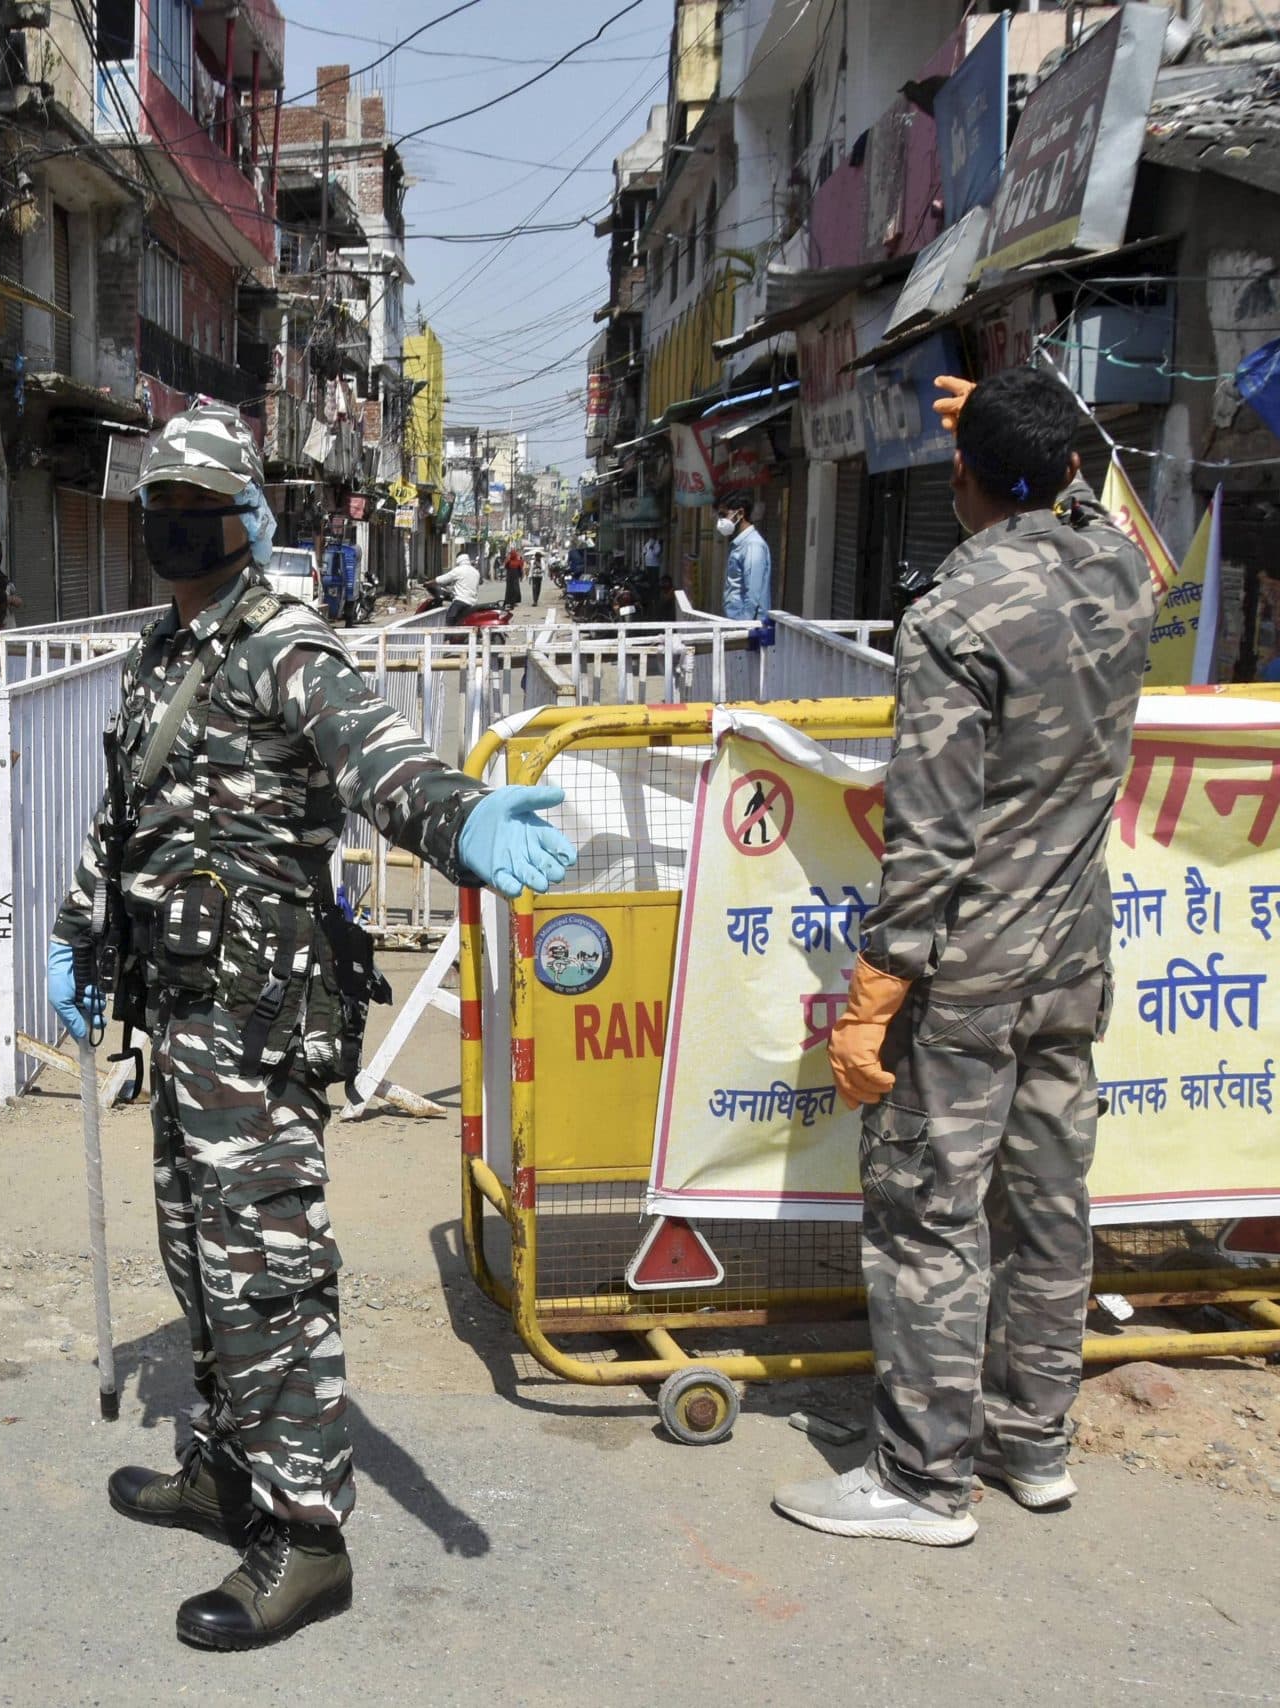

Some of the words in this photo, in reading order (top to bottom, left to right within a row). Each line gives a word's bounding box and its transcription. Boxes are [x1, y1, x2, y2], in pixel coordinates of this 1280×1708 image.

[727, 906, 772, 955] यह
[791, 886, 879, 953] कोरो
[1249, 884, 1280, 941] इ
[1137, 952, 1267, 1036] वर्जित
[575, 1001, 664, 1061] RAN
[709, 1080, 837, 1127] अनाधिकृत
[1180, 1058, 1276, 1115] कार्रवाई
